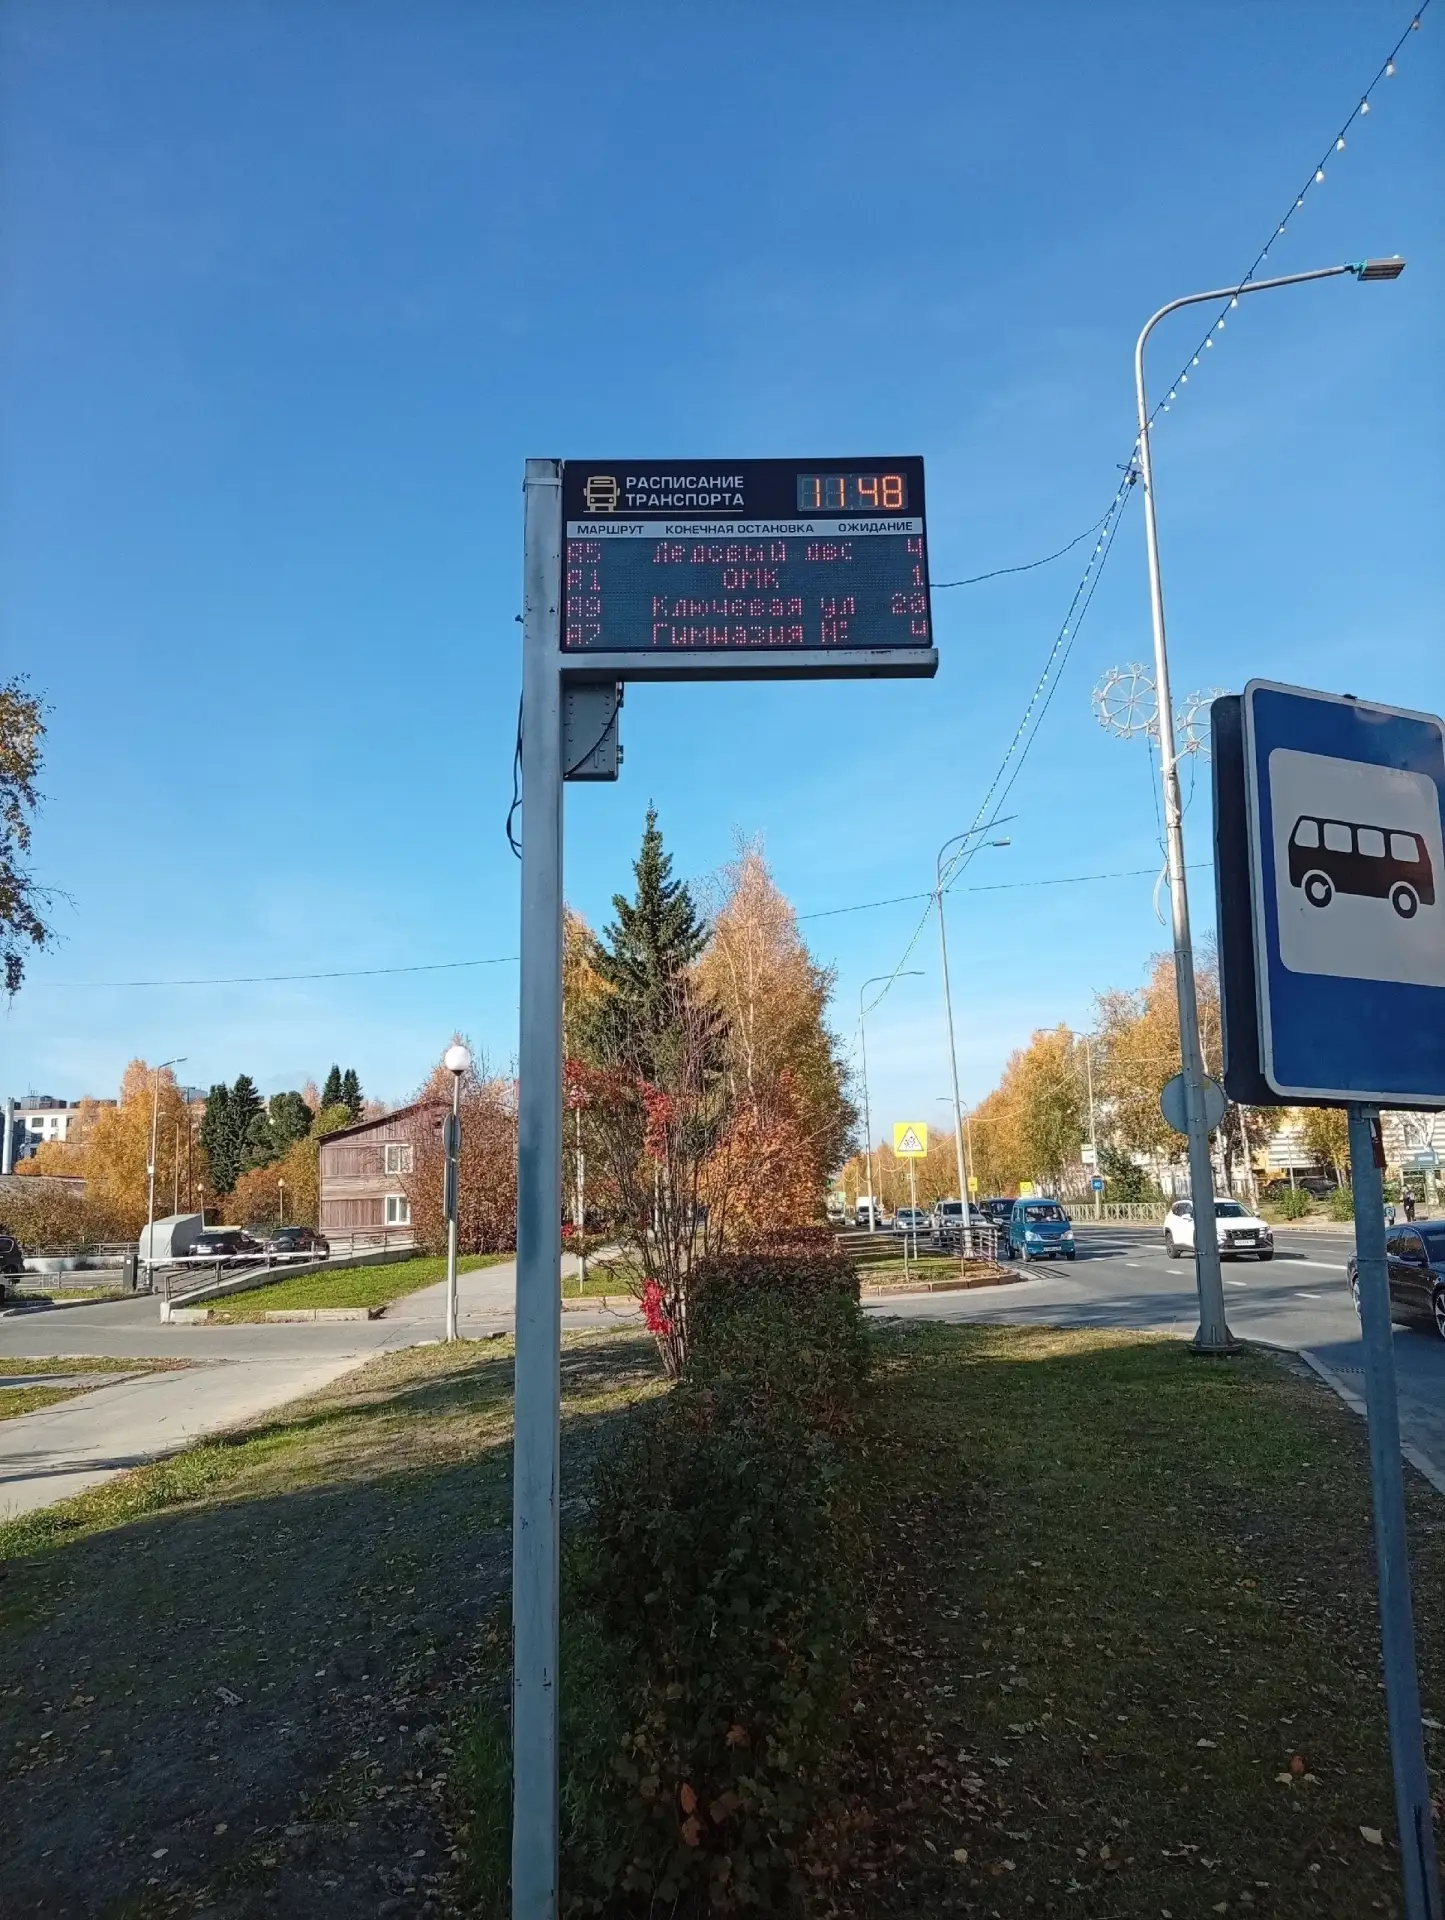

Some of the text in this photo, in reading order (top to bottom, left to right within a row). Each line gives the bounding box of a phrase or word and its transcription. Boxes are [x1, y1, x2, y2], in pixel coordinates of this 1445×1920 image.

[625, 476, 744, 489] РАСПИСАНИЕ
[625, 493, 745, 506] ТРАНСПОРТА
[577, 521, 913, 535] МАРШРУТ КОНЕЧНАЯ ОСТАНОВКА ОЖИДАНИЕ
[907, 538, 923, 559] 4
[723, 568, 779, 589] ОМК
[912, 565, 924, 586] 1
[653, 595, 802, 617] Ключевая
[821, 596, 856, 619] ул
